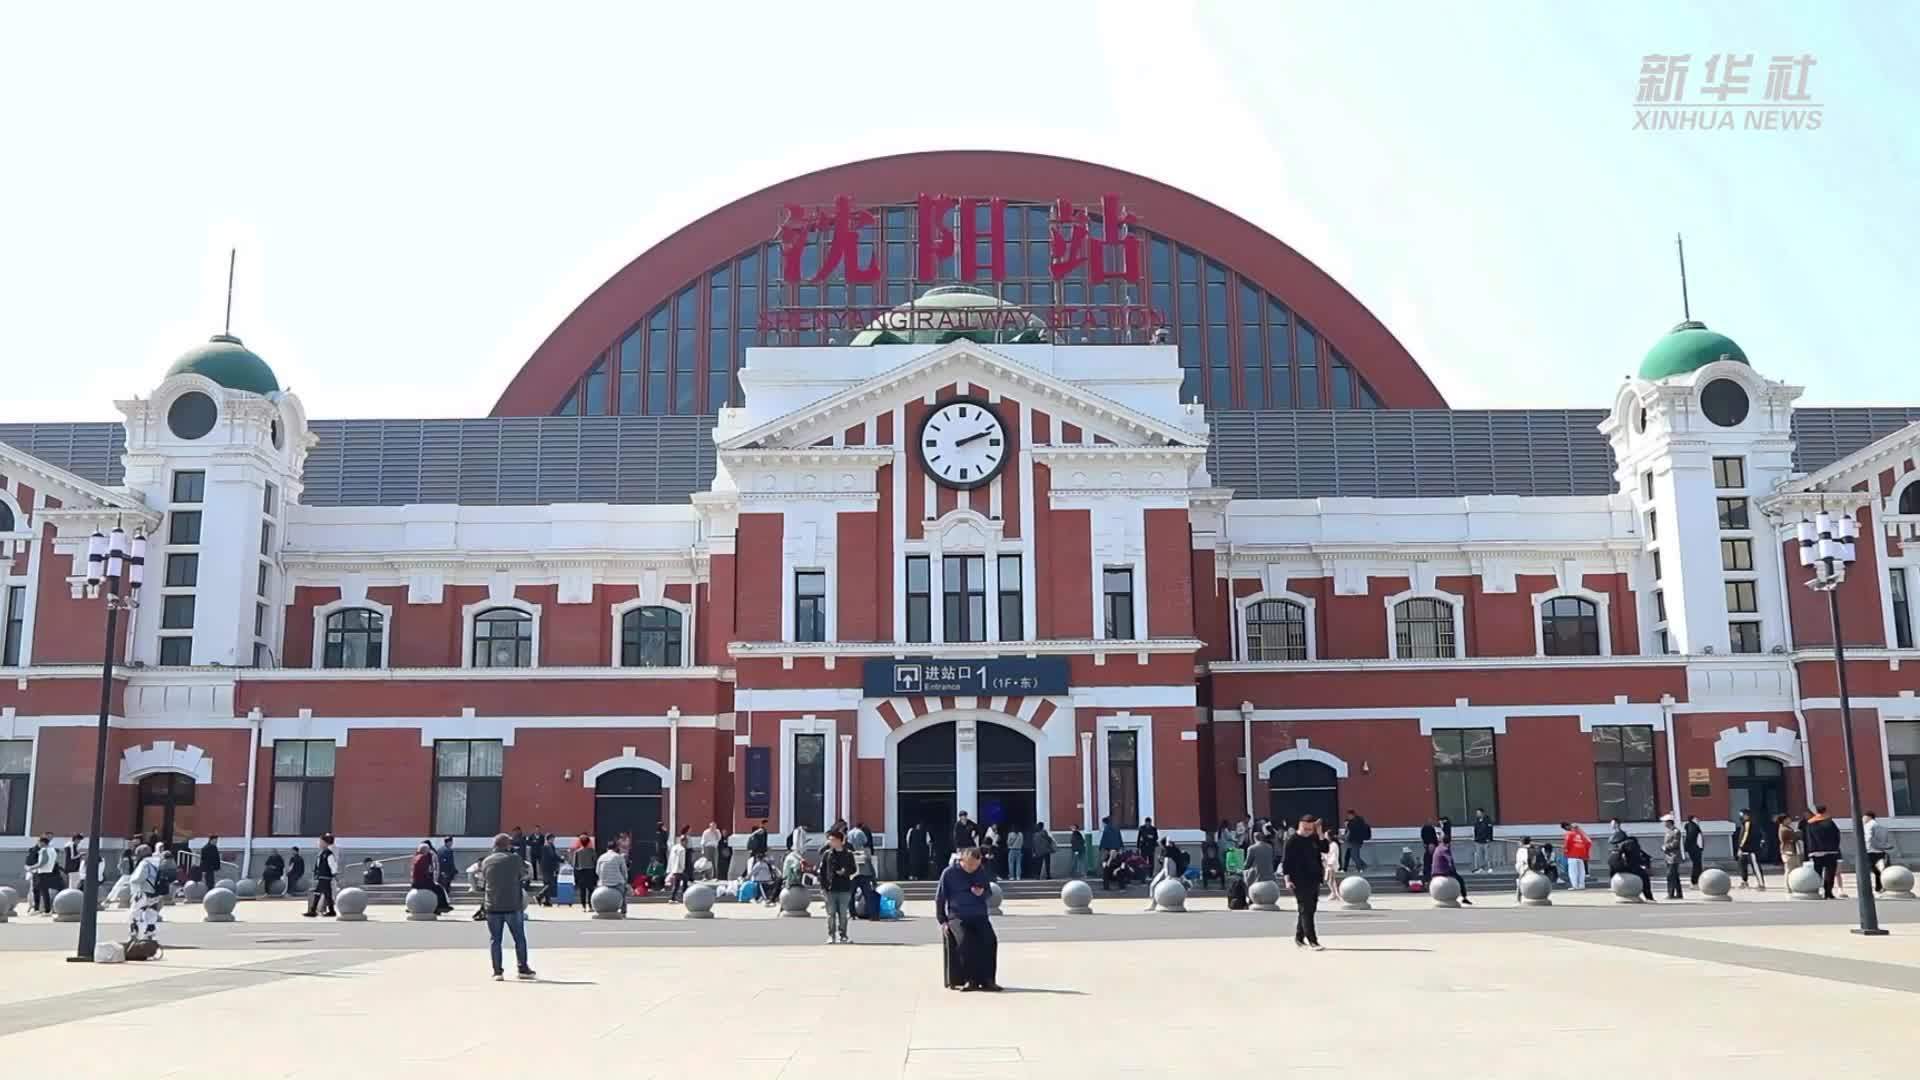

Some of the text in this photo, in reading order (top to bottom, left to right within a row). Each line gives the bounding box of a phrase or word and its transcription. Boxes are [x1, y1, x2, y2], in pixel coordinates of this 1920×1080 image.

[782, 192, 1141, 284] 沈阳站
[758, 306, 1167, 331] SHENYANG RAILWAY STATION
[924, 683, 961, 691] Entrance
[925, 666, 971, 680] 进站口
[976, 666, 989, 689] 1
